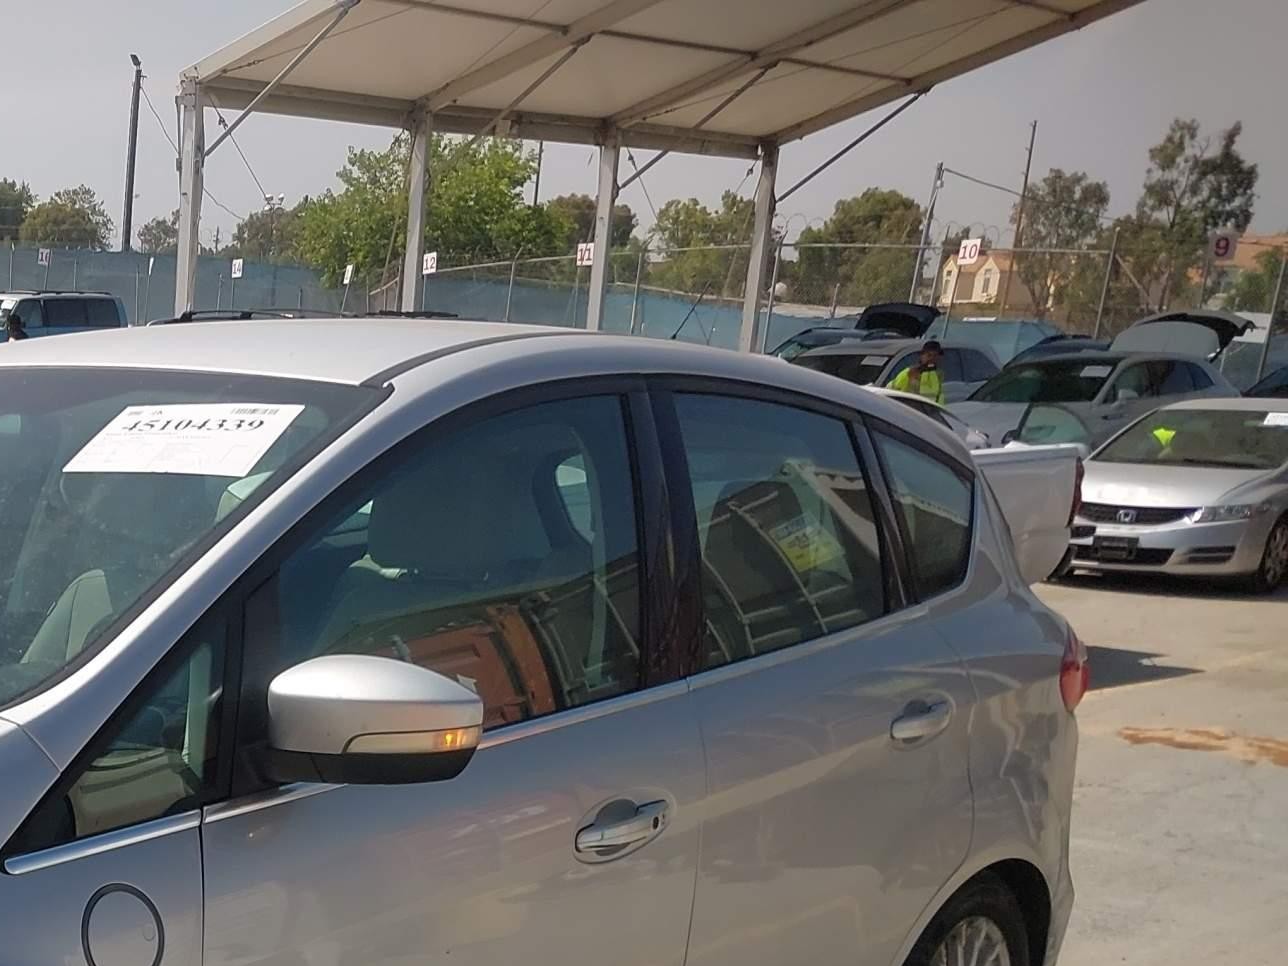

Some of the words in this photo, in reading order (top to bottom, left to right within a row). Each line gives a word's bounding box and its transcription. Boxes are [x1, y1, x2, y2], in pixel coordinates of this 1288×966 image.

[959, 244, 978, 260] 10
[1214, 236, 1230, 257] 9
[232, 260, 242, 274] 14
[423, 256, 436, 272] 12
[121, 417, 265, 433] 45104339
